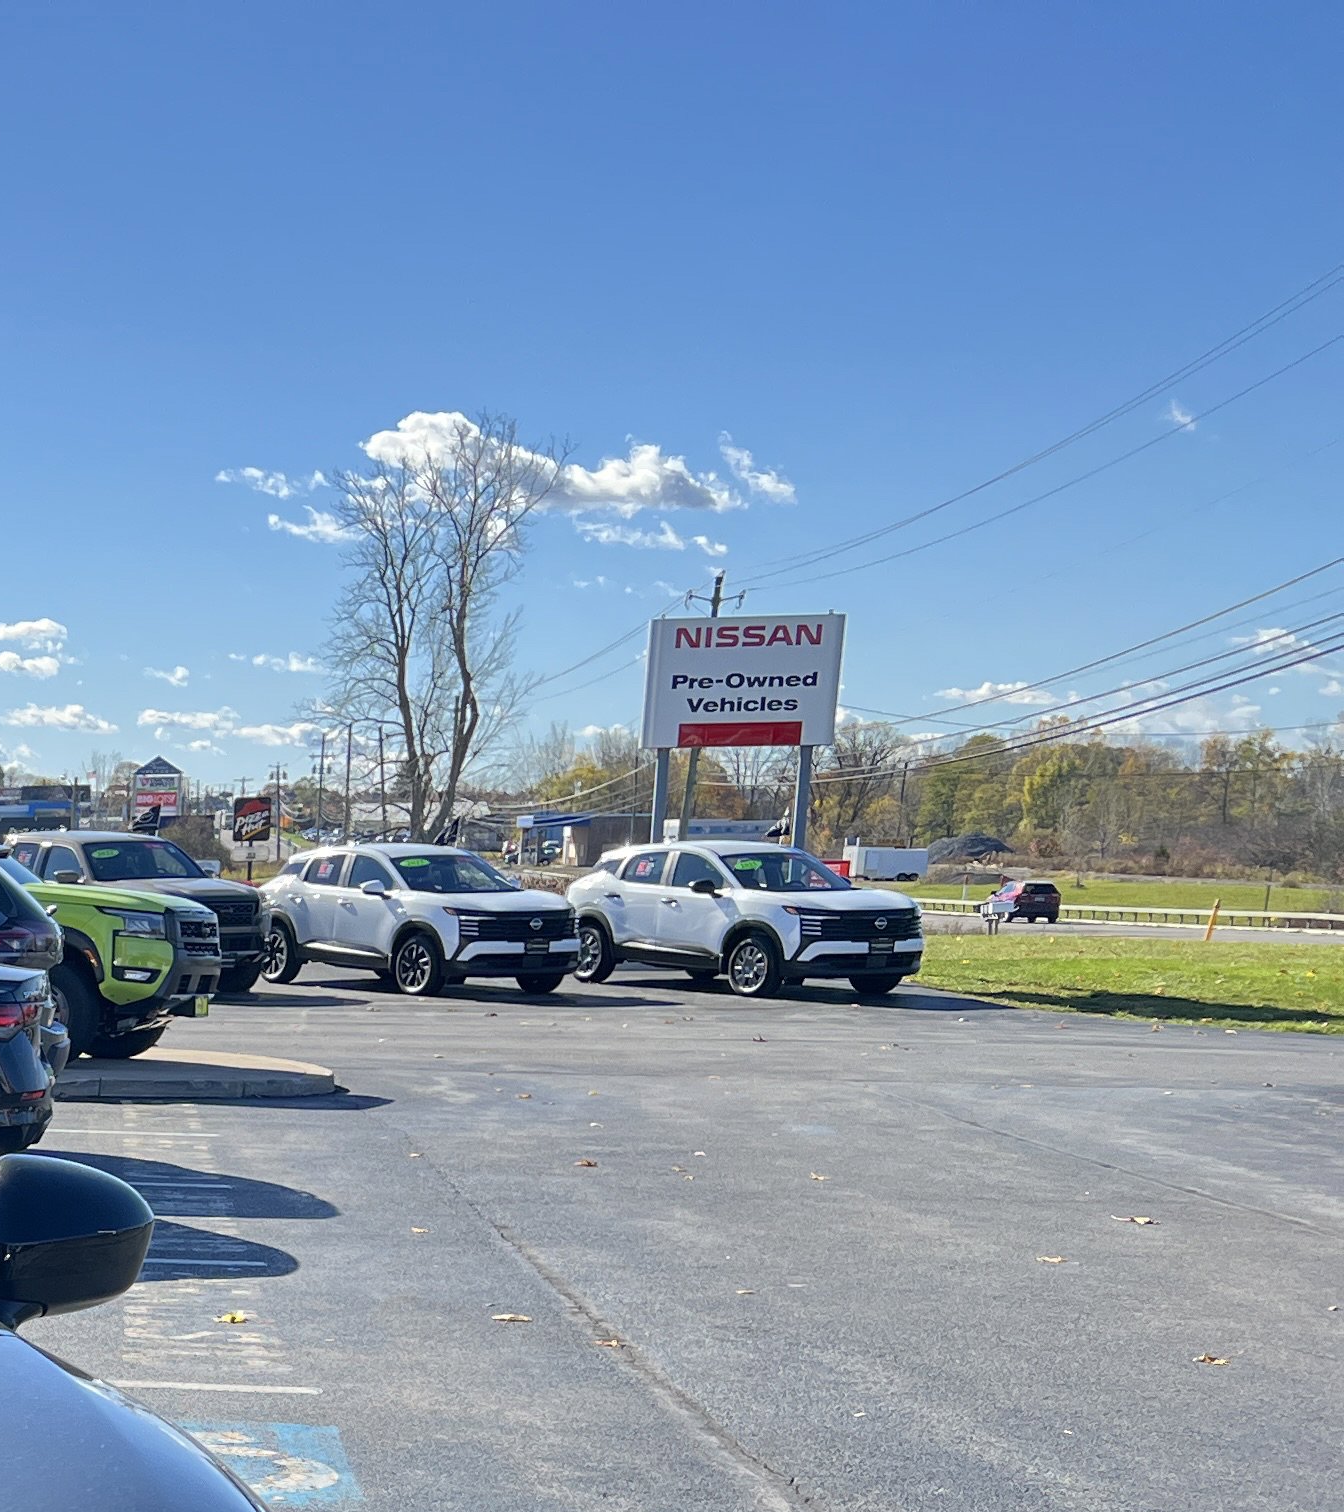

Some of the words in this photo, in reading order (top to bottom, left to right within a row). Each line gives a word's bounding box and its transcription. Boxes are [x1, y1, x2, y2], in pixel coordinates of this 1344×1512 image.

[676, 624, 823, 648] NISSAN
[672, 672, 818, 689] Pre-Owned
[687, 697, 798, 712] Vehicles
